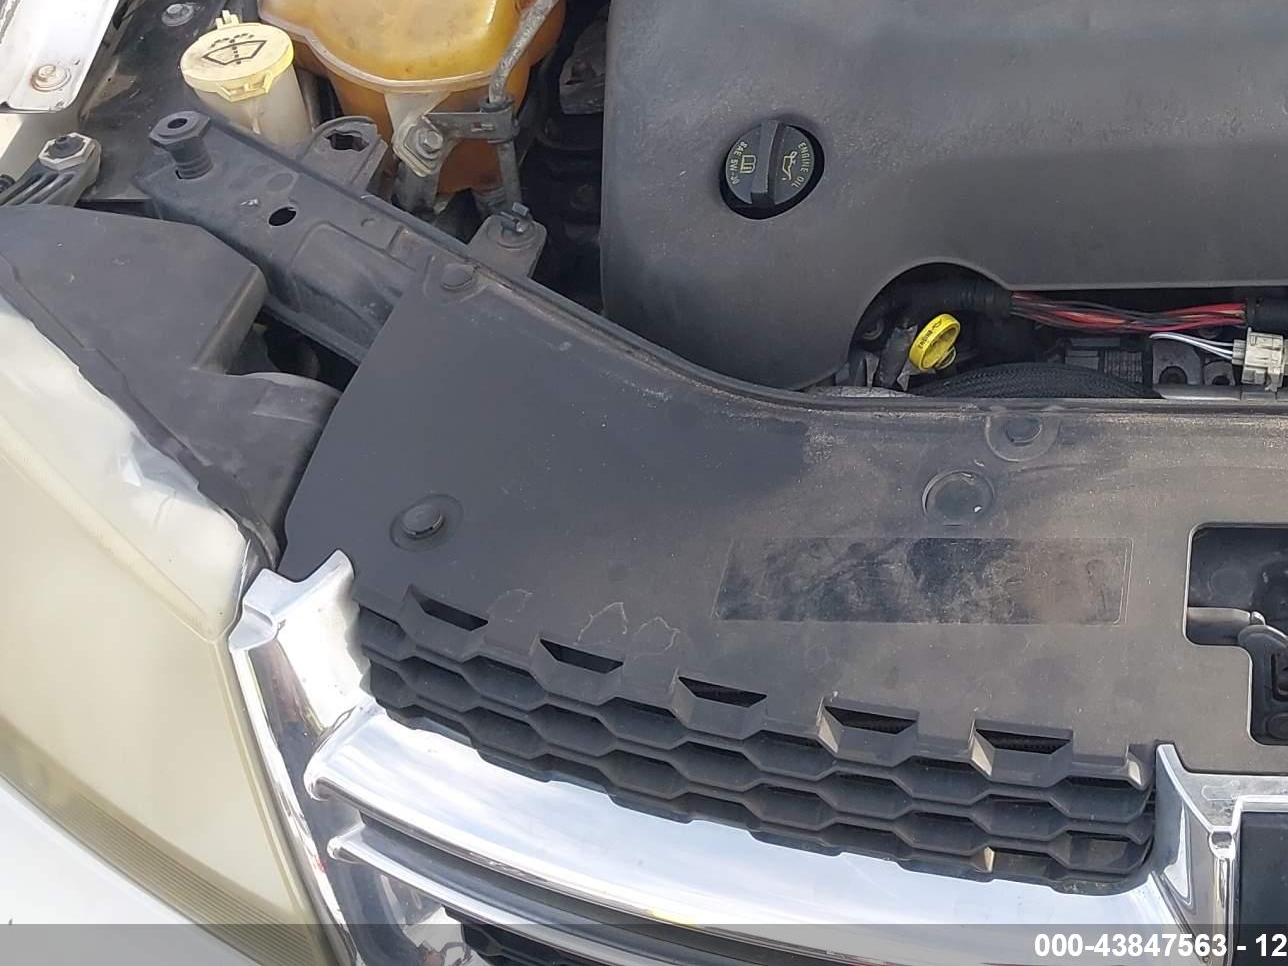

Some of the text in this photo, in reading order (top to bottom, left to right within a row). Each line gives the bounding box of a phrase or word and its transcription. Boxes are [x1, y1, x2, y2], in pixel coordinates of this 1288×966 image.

[734, 141, 748, 157] SAE
[791, 141, 809, 188] ENGINE OIL
